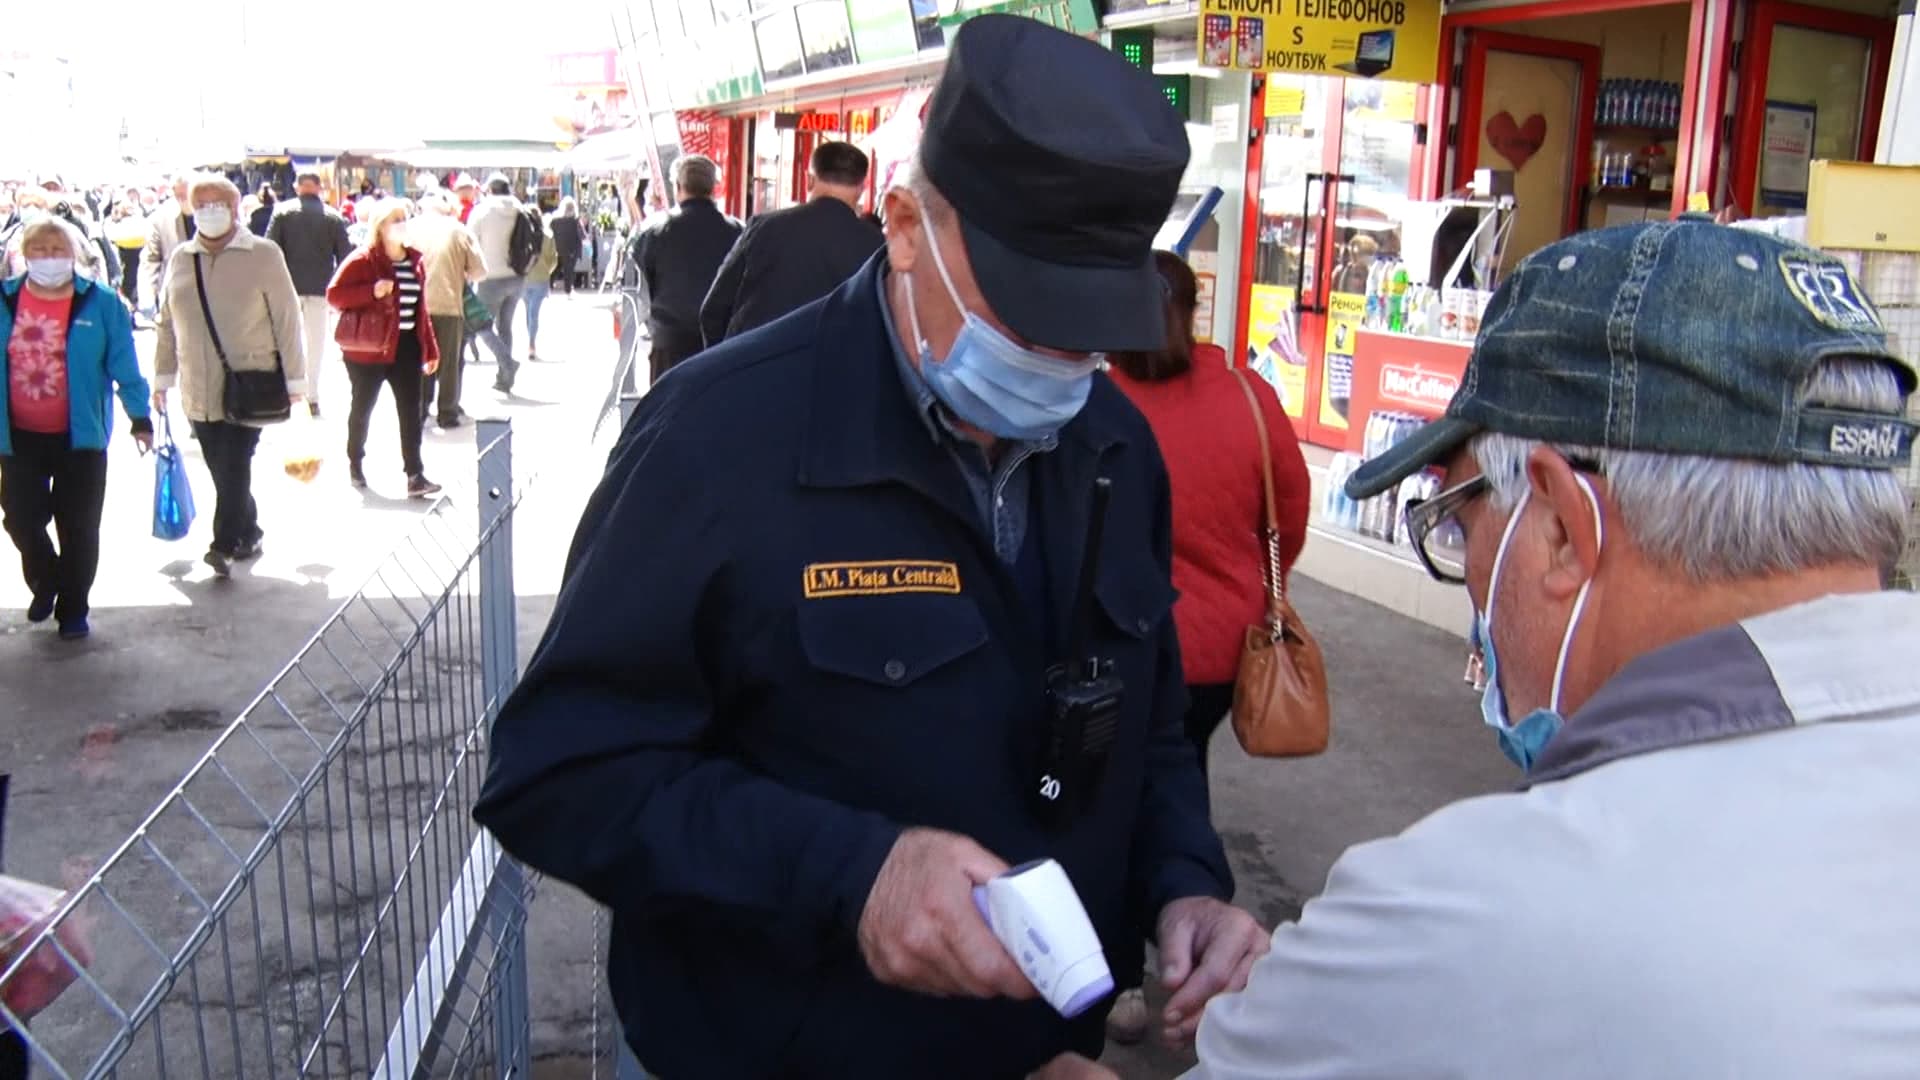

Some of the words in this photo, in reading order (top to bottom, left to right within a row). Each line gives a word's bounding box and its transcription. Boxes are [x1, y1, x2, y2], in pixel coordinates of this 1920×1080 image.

[1295, 0, 1405, 25] ТЕЛЕФОНОВ
[1266, 49, 1327, 70] НОУТБУК
[1830, 422, 1901, 458] ESPAÑA
[1039, 774, 1061, 800] 20
